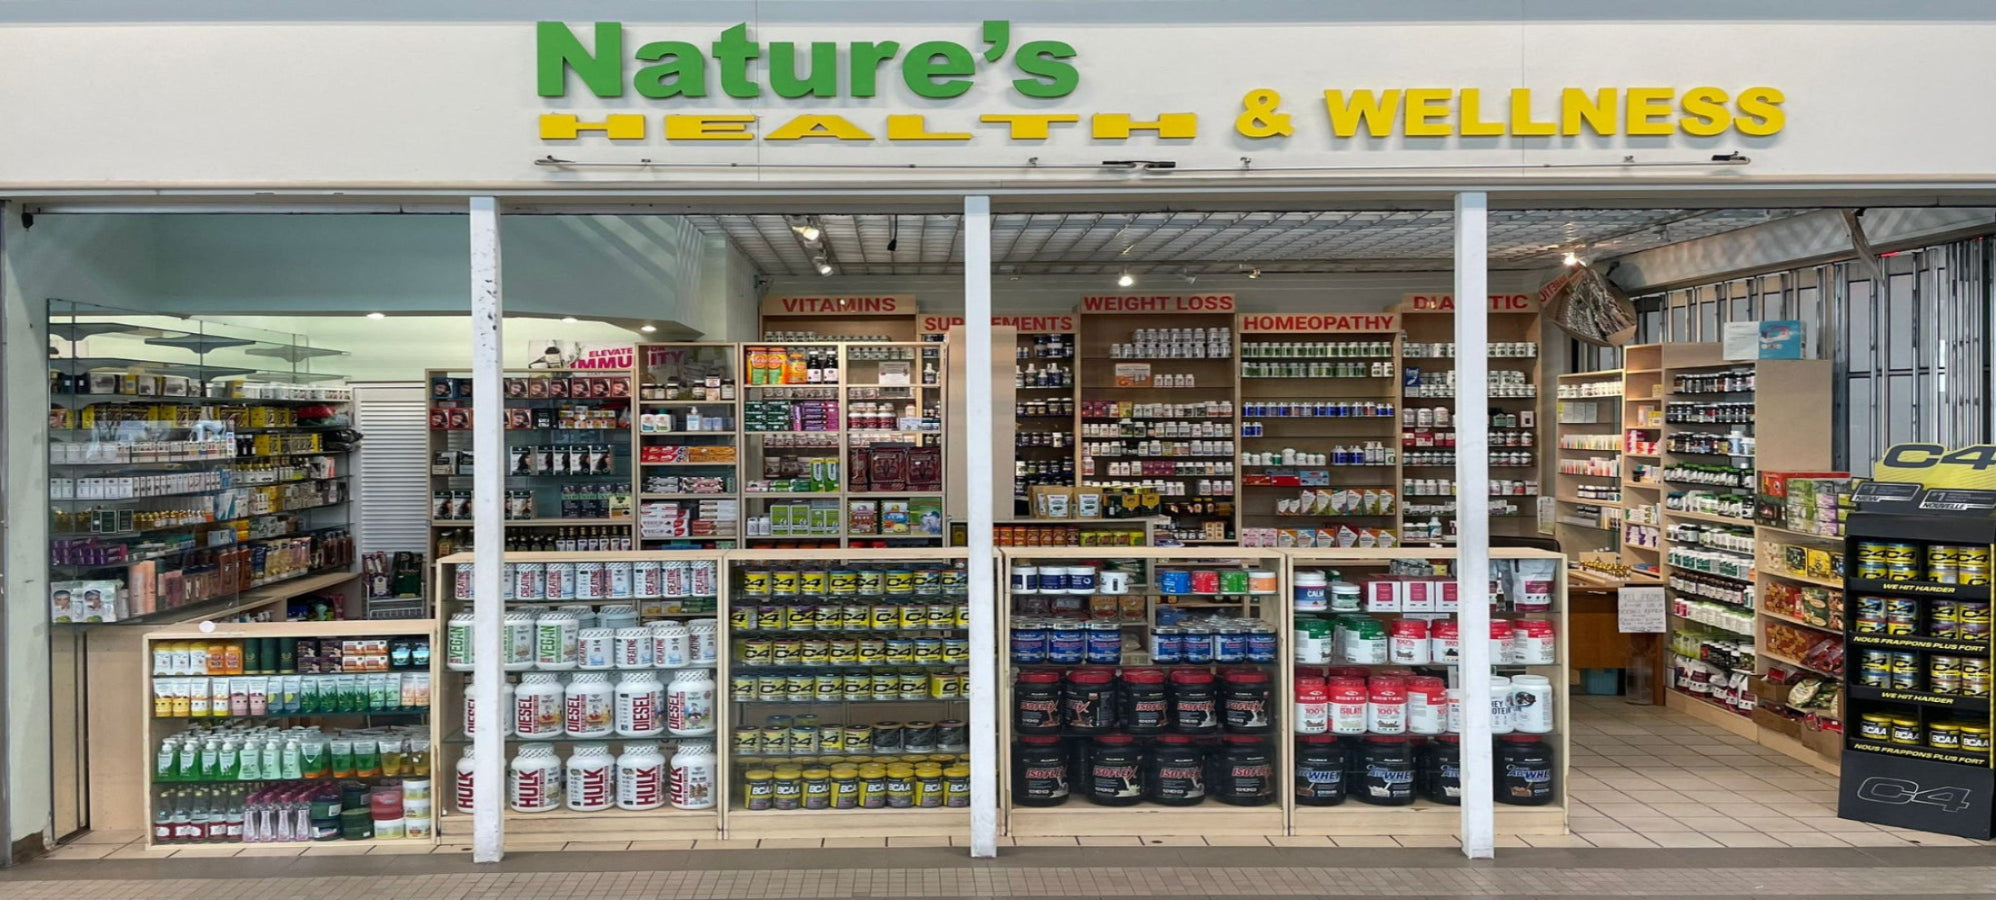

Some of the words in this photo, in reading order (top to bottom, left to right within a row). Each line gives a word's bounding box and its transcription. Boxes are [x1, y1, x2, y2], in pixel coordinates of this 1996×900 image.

[537, 19, 1080, 99] Nature's
[538, 113, 1197, 141] HEALTH
[1235, 88, 1294, 138] &
[1323, 86, 1786, 137] WELLNESS
[782, 297, 896, 313] VITAMINS
[1084, 296, 1170, 311] WEIGHT
[1176, 296, 1233, 310] LOSS
[1413, 295, 1528, 311] DIATIC
[924, 316, 1073, 331] SUPEMENTS
[1243, 314, 1394, 331] HOMEOPATHY
[570, 352, 684, 369] IMMUITY
[589, 347, 633, 357] ELEVATE
[1883, 444, 1996, 470] C4
[450, 625, 464, 658] VEGAN
[540, 625, 556, 657] VEGAN
[1881, 638, 1931, 647] FRAPPONS
[518, 695, 532, 733] DIESEL
[567, 694, 581, 732] DIESEL
[633, 693, 650, 731] DIESEL
[668, 692, 680, 729] DIESEL
[1913, 695, 1954, 704] HARDER
[1854, 743, 1880, 751] NOUS
[1881, 747, 1932, 758] FRAPPONS
[1933, 753, 1958, 762] PLUS
[1958, 757, 1985, 765] FORT
[458, 770, 474, 809] HULK
[519, 769, 539, 808] HULK
[583, 767, 604, 806] HULK
[636, 766, 656, 805] HULK
[670, 767, 682, 805] HULK
[1857, 776, 1972, 813] C4
